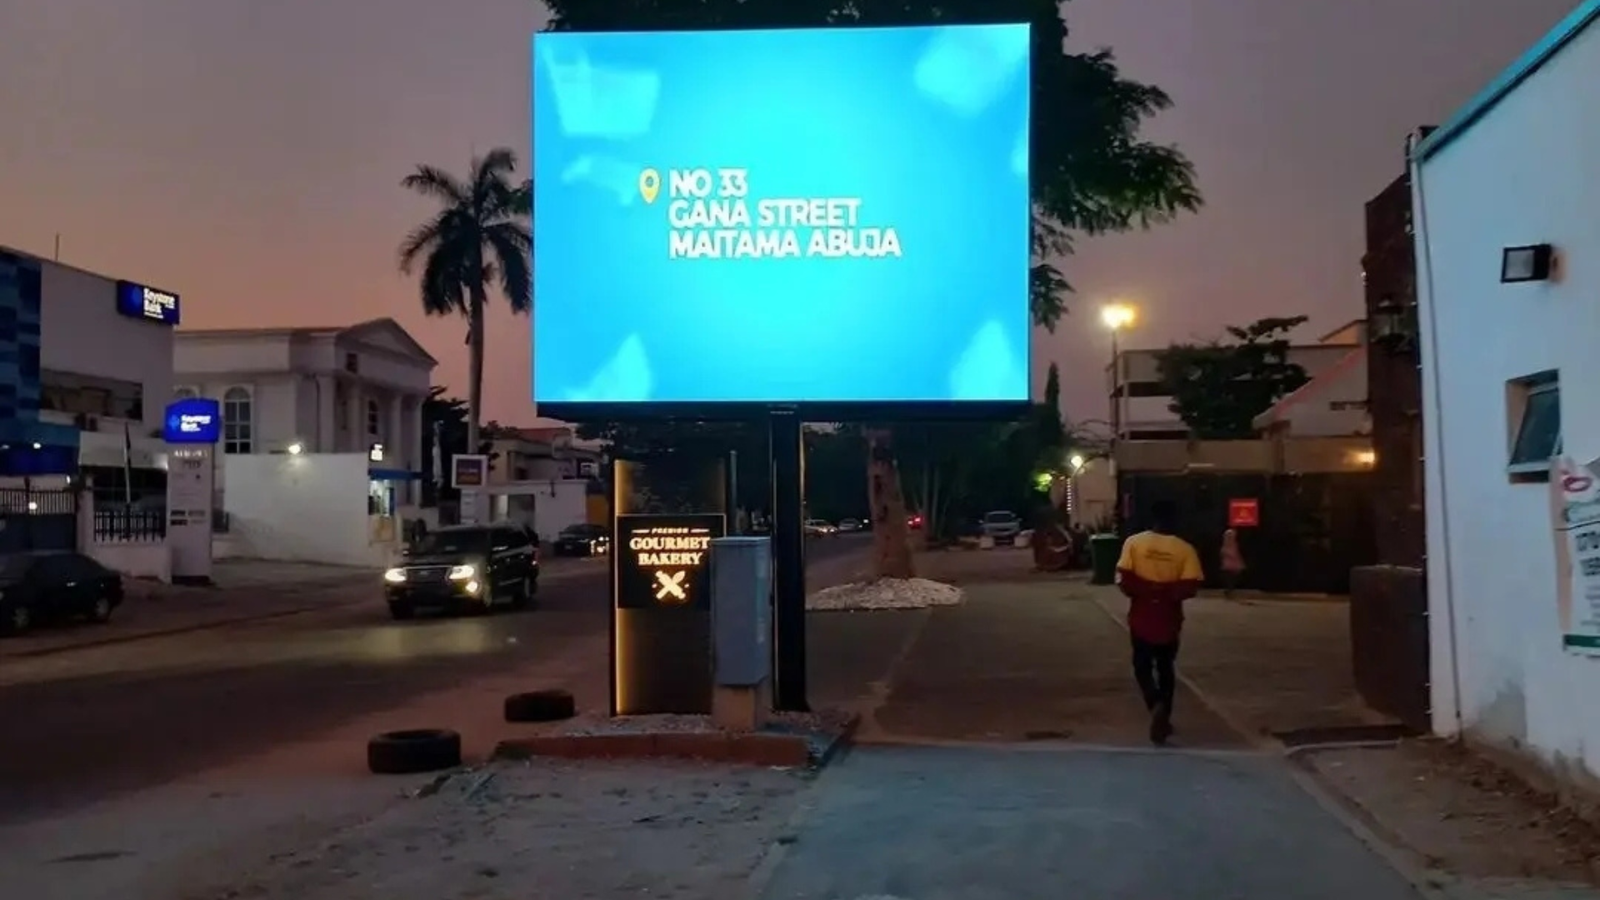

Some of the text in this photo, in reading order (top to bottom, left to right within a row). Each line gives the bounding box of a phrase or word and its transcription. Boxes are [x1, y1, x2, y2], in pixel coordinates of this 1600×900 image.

[668, 168, 748, 198] NO 33
[668, 197, 862, 229] GANA STREET
[668, 227, 902, 259] MAITAMA ABUJA
[629, 536, 711, 550] GOURMET
[638, 552, 703, 566] BAKERY
